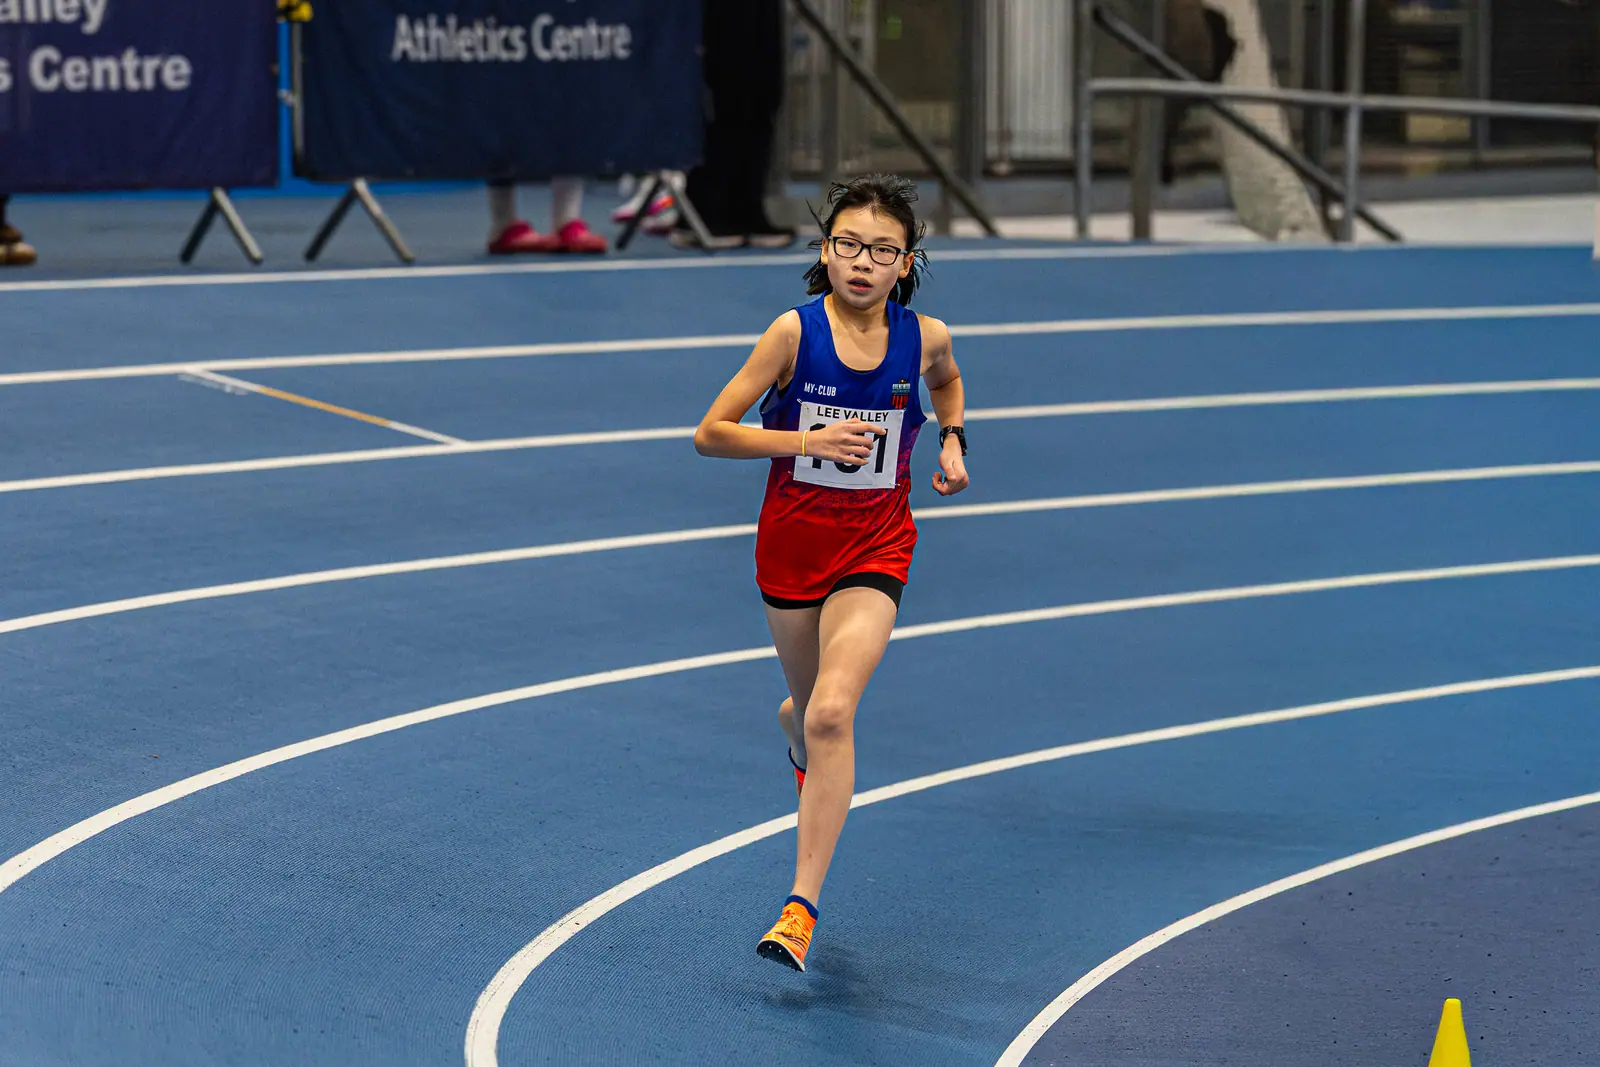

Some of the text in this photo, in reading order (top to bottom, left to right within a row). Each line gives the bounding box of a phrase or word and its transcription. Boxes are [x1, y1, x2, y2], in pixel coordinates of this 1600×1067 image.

[392, 13, 632, 62] Athletics Centre
[29, 45, 192, 92] Centre
[817, 406, 889, 423] LEE VALLEY
